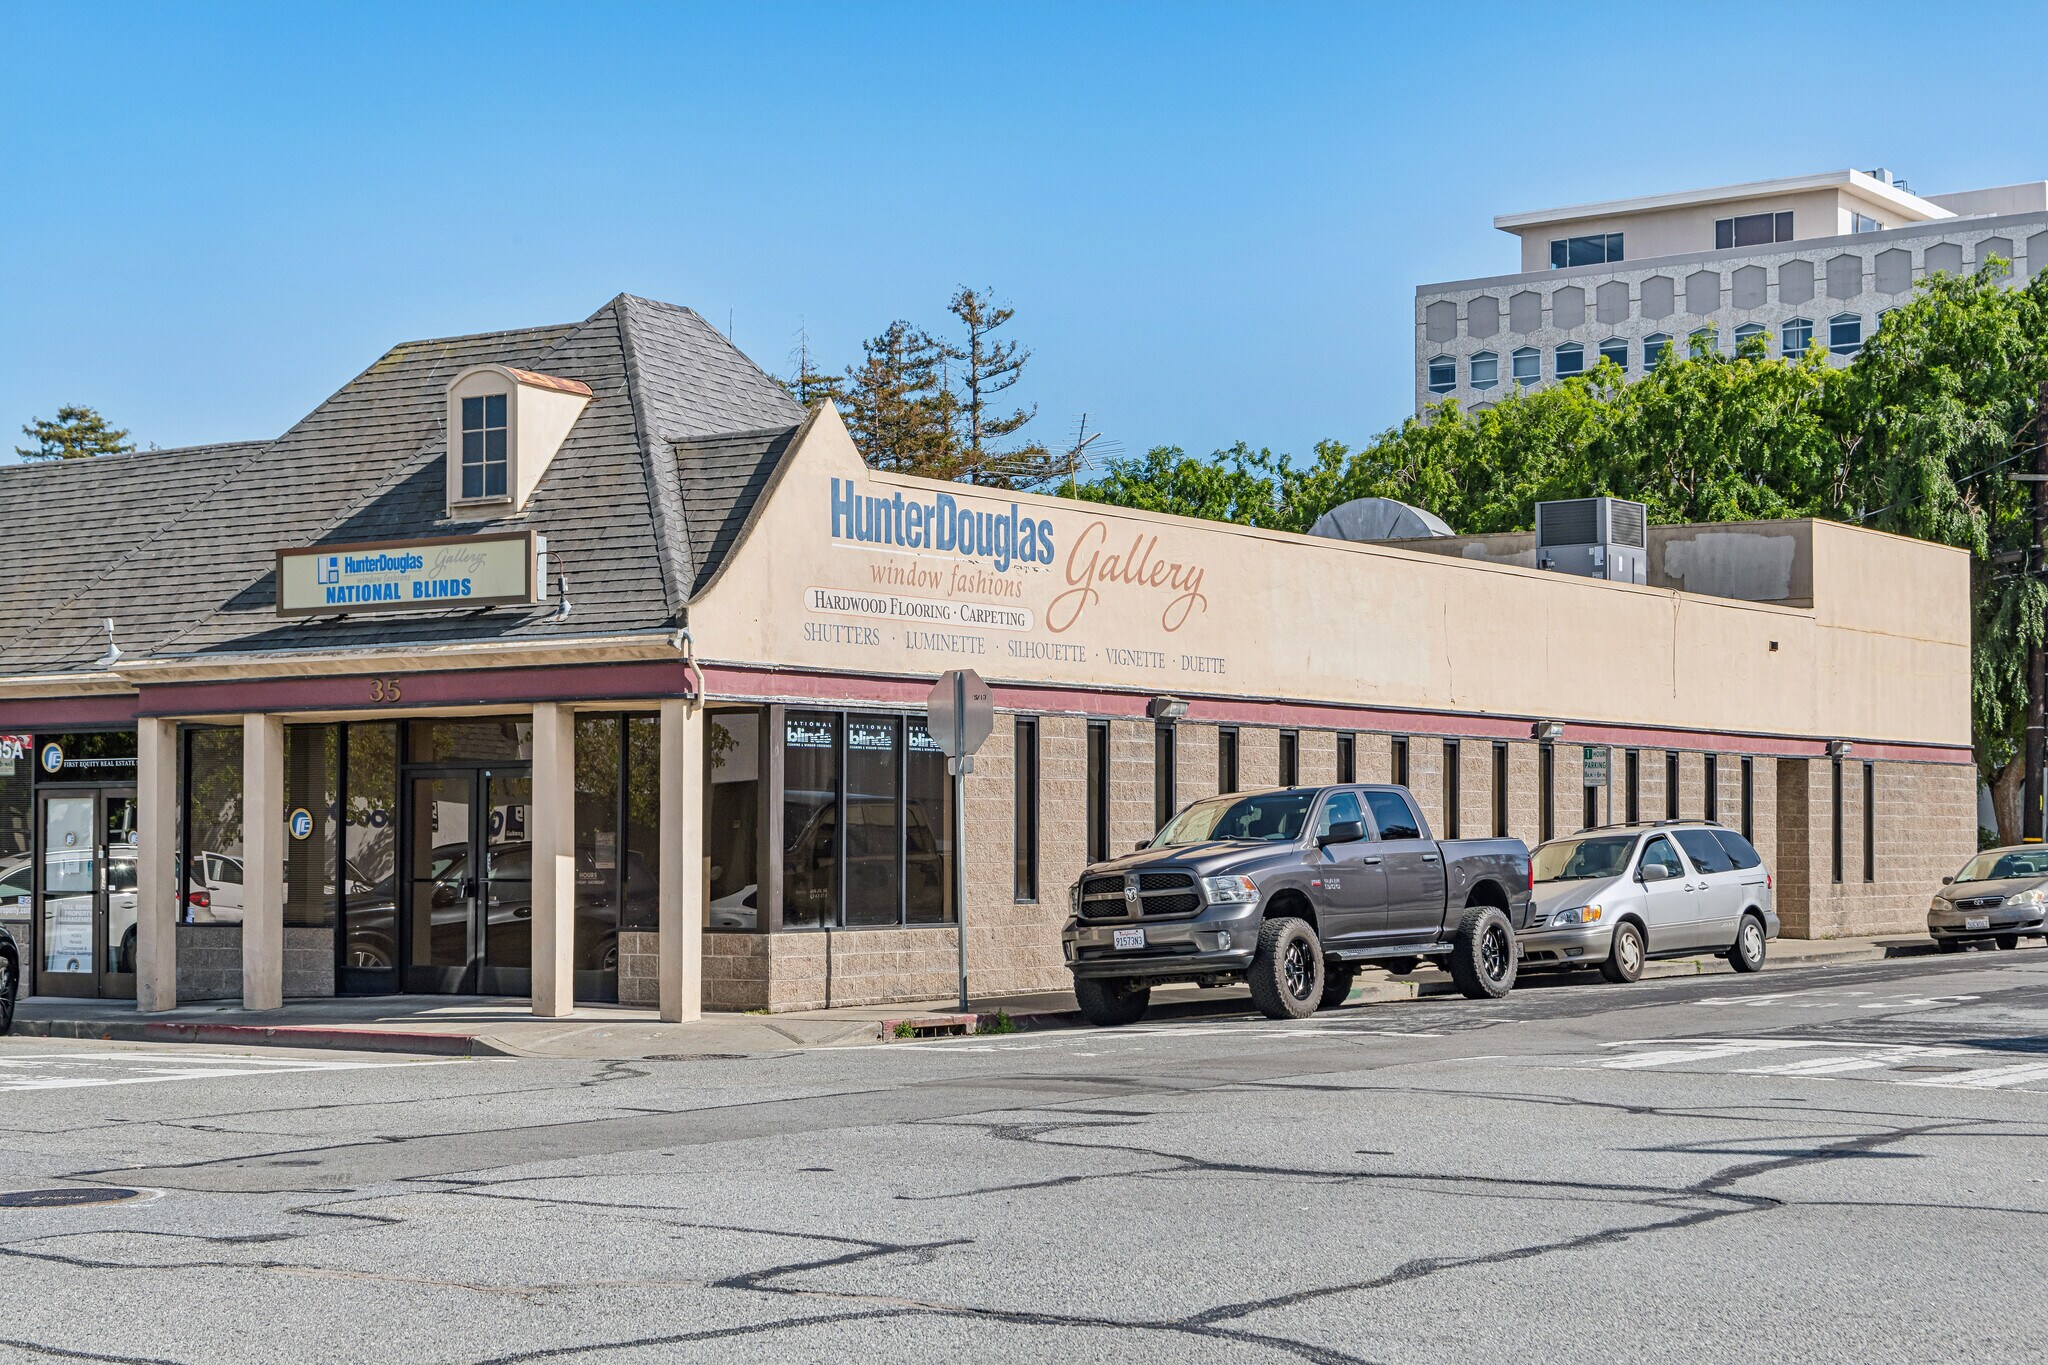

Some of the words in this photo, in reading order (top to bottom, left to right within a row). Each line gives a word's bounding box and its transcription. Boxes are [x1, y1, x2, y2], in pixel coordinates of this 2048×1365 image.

[830, 477, 1055, 573] HunterDouglas
[345, 552, 423, 574] HunterDouglas
[428, 548, 486, 579] Gallery
[870, 560, 943, 591] window
[946, 562, 1022, 599] fashions
[1046, 521, 1208, 633] Gallery
[326, 582, 401, 604] NATIONAL
[413, 578, 472, 598] BLINDS
[803, 622, 880, 646] SHUTTERS
[905, 631, 986, 655] LUMINETTE
[1007, 640, 1087, 663] SILHOUETTE
[1106, 648, 1166, 669] VIGNETTE
[1181, 656, 1226, 675] DUETTE
[370, 678, 401, 702] 35
[787, 727, 832, 744] blinds
[849, 730, 892, 746] blinds
[79, 761, 99, 769] EQUITY
[1584, 761, 1606, 769] PARKING
[1116, 936, 1143, 947] 91573N3
